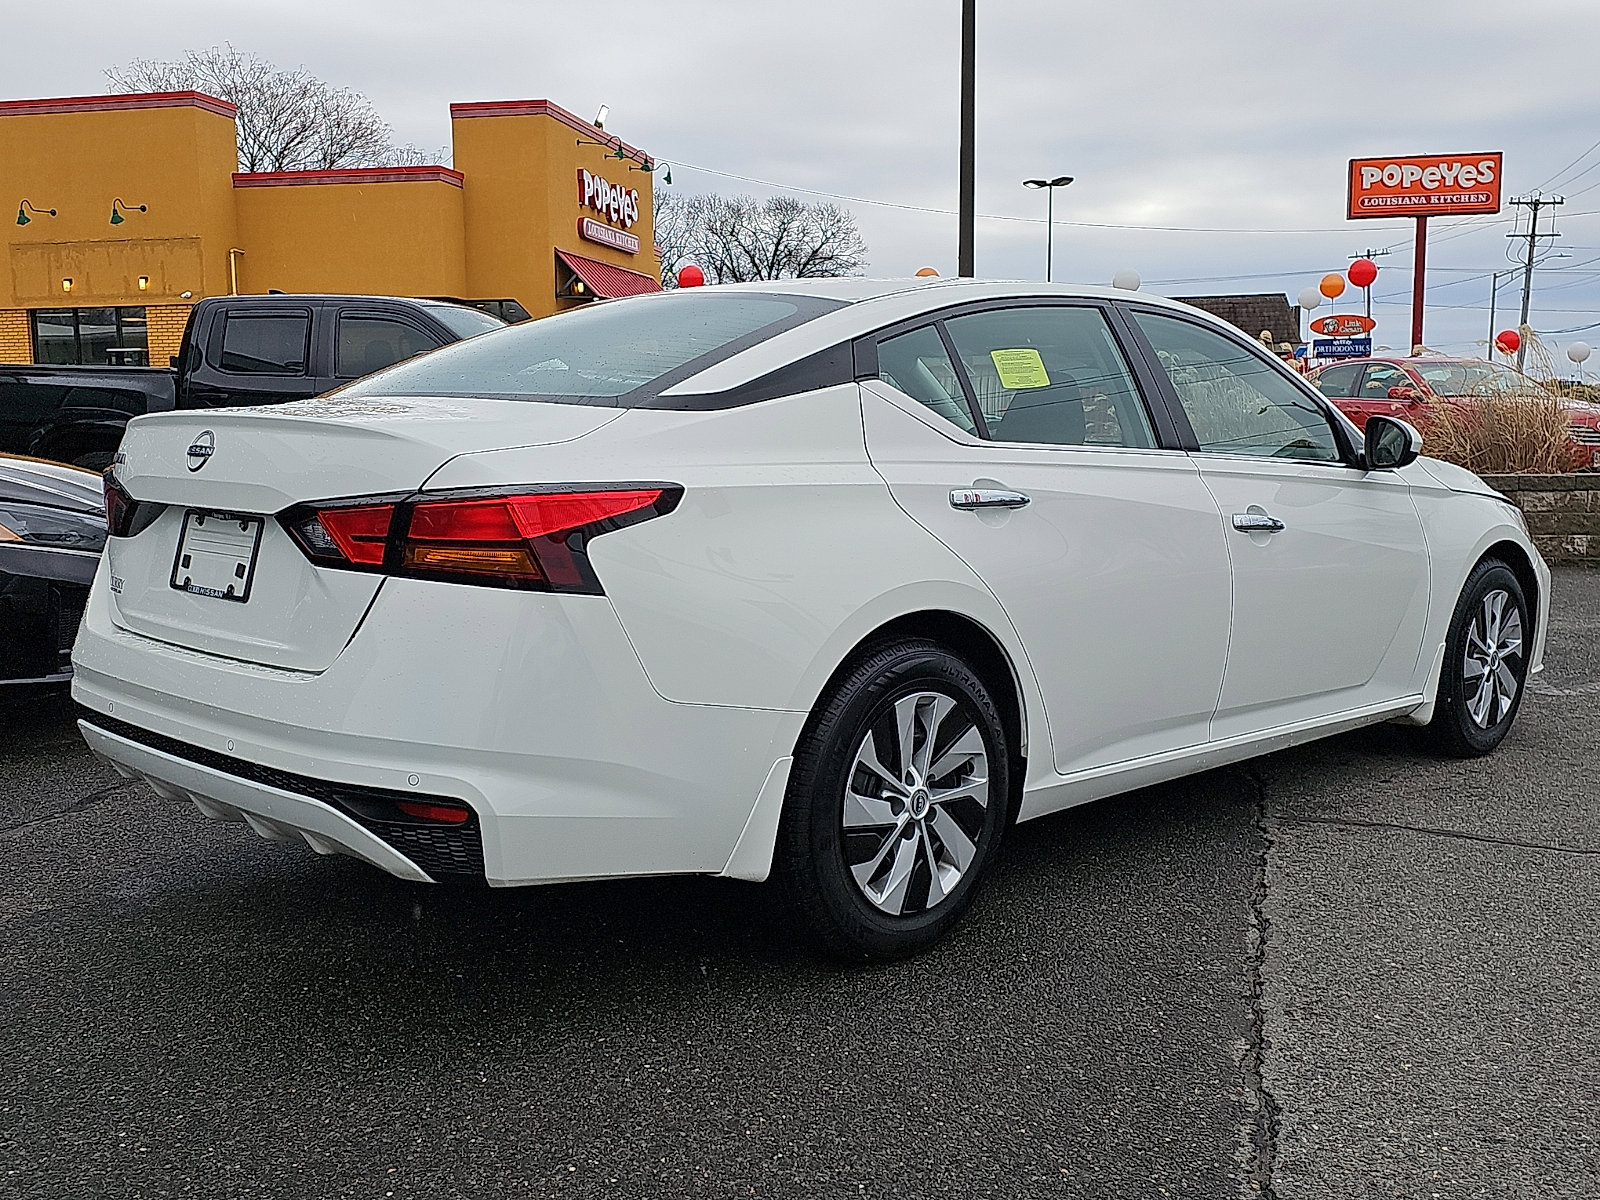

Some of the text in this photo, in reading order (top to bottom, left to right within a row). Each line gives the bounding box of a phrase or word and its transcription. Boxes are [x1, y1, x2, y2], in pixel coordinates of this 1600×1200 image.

[1361, 161, 1495, 189] POPeYeS
[583, 169, 638, 228] POPeYeS
[1363, 193, 1488, 206] LOUISIANA KITCHEN
[1315, 345, 1371, 353] ORTHODONTICS
[199, 588, 224, 598] NISSAN
[941, 665, 998, 722] ULTRAMAX
